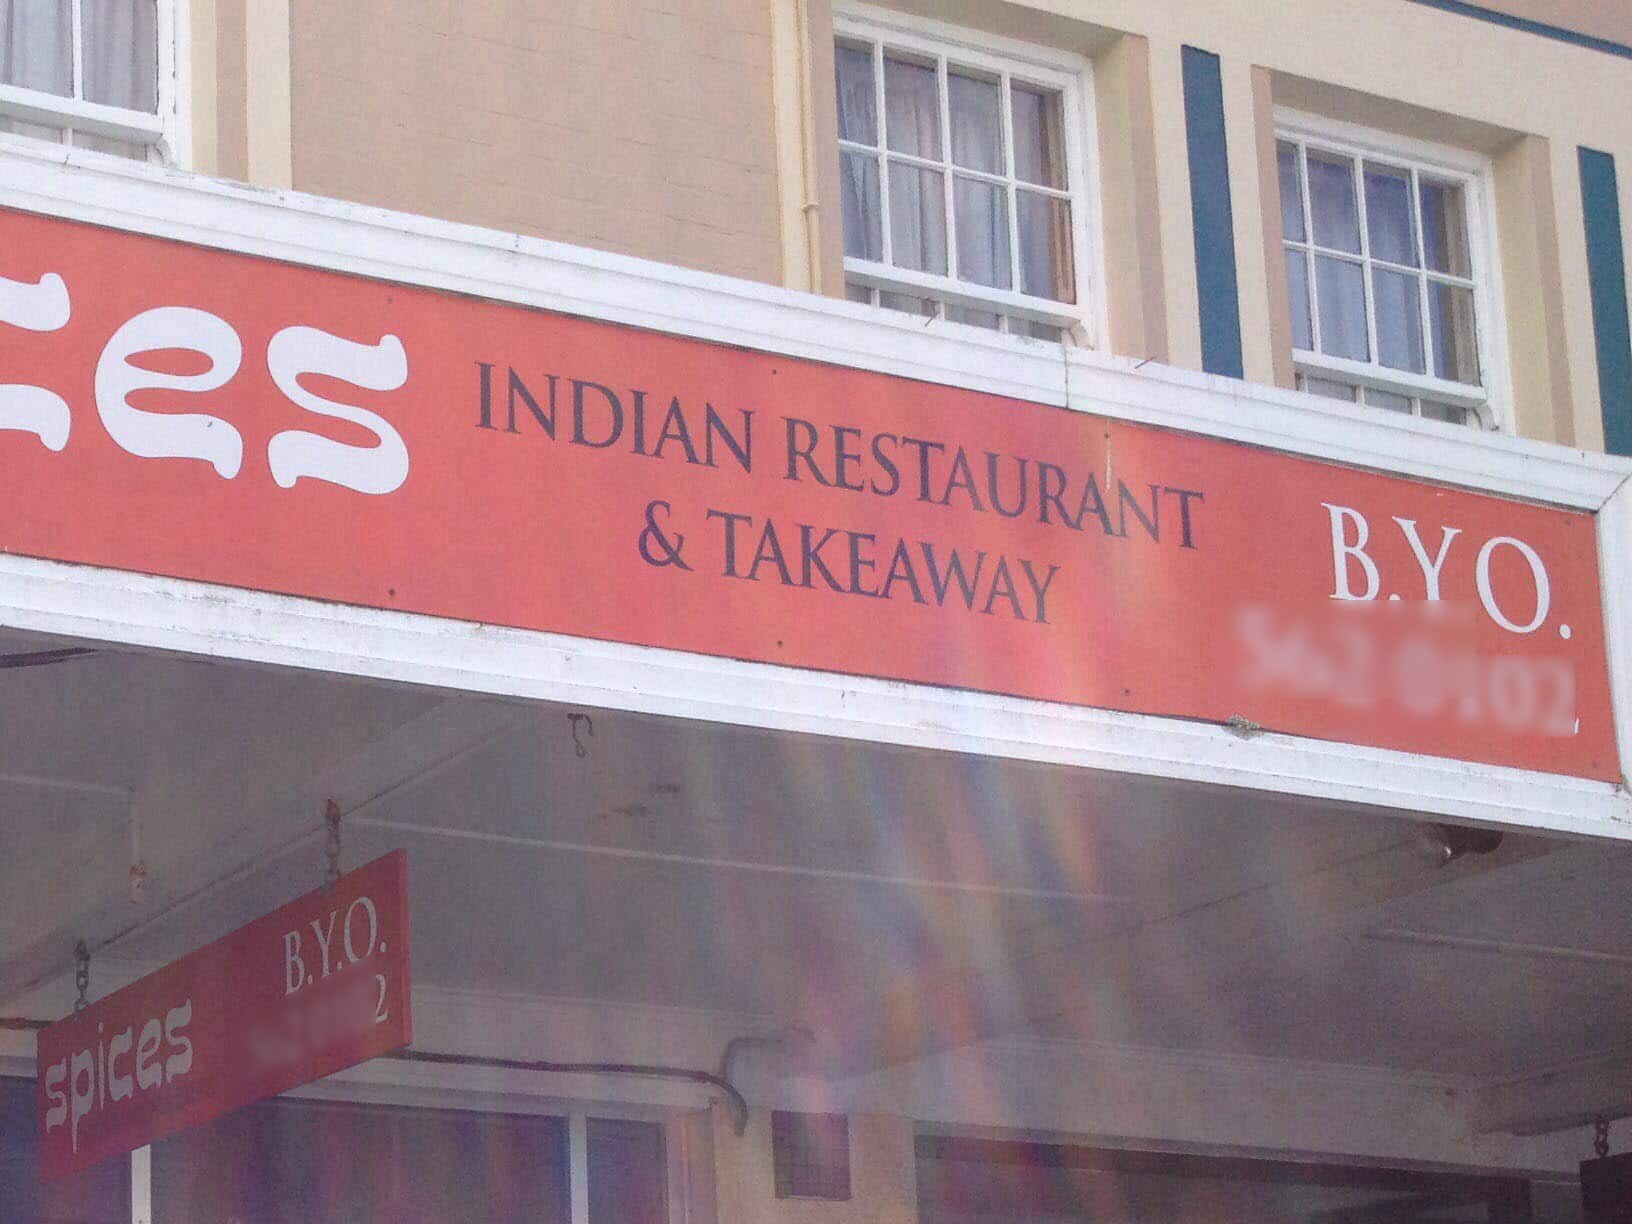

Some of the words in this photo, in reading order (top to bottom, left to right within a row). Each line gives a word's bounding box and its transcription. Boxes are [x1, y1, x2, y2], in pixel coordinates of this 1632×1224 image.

[475, 361, 755, 475] INDIAN
[782, 415, 1206, 551] RESTAURANT
[636, 499, 692, 570] &
[705, 508, 1062, 626] TAKEAWAY
[44, 997, 194, 1155] spices
